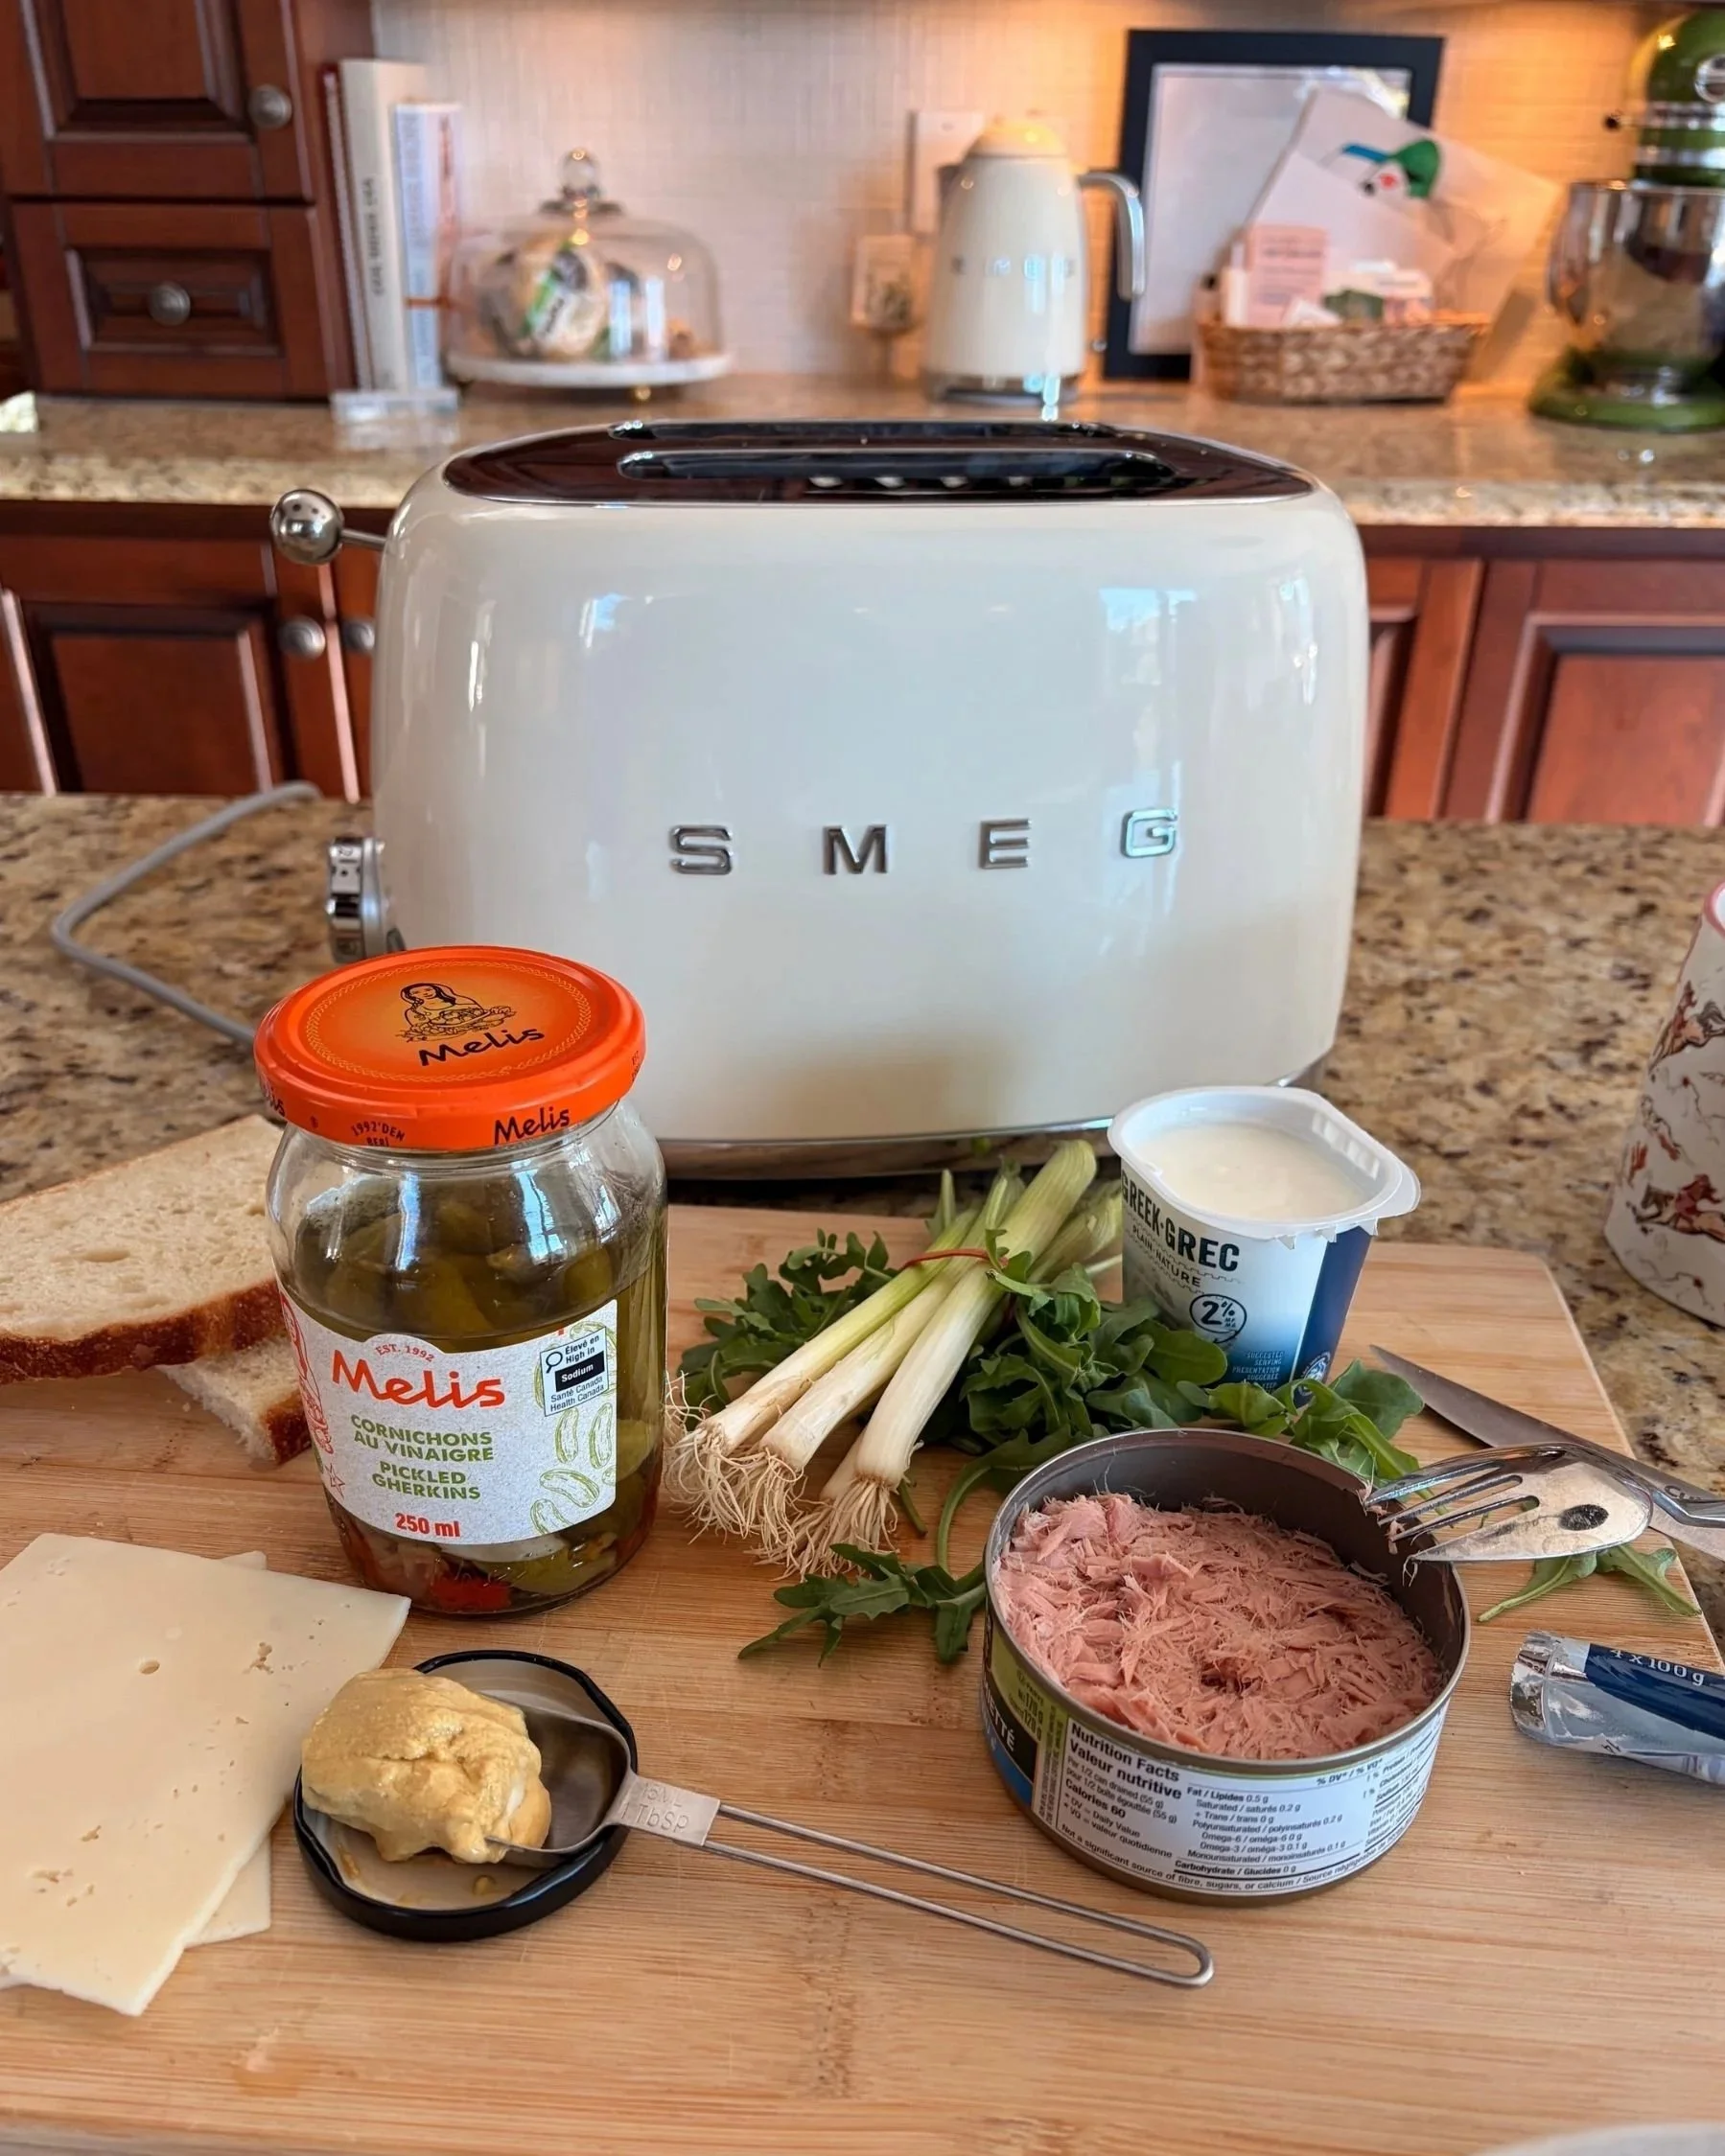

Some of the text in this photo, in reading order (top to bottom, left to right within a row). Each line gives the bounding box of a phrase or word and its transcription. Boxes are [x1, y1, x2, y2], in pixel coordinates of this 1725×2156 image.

[418, 1028, 545, 1067] Melis
[494, 1106, 571, 1146] Melis
[1155, 1251, 1202, 1287] NATURE
[375, 1343, 435, 1363] EST. 1992
[565, 1334, 600, 1355] Élevé en
[566, 1346, 595, 1364] High in
[332, 1349, 506, 1409] Melis
[561, 1363, 594, 1382] Sodium
[549, 1383, 605, 1413] Health Canada
[550, 1375, 603, 1403] Santé Canada
[350, 1413, 494, 1446] CORNICHONS
[353, 1430, 495, 1462] AU VINAIGRE
[371, 1472, 481, 1500] GHERKINS
[379, 1460, 467, 1485] PICKLED
[394, 1512, 461, 1538] 250 ml
[1649, 1658, 1688, 1678] 100
[1691, 1672, 1706, 1687] g
[1071, 1723, 1180, 1782] Nutrition Facts
[1070, 1738, 1182, 1800] Valeur nutritive
[1065, 1778, 1127, 1820] Calories 60
[1186, 1786, 1202, 1797] Fat
[1210, 1791, 1245, 1802] Lipides
[1246, 1794, 1261, 1802] 0.5
[1262, 1796, 1270, 1804] g
[1196, 1799, 1239, 1813] Saturated
[1278, 1803, 1294, 1813] 0.2
[1294, 1803, 1301, 1813] g
[1092, 1810, 1114, 1828] Daily
[1115, 1821, 1141, 1839] Value
[1192, 1820, 1261, 1834] Polyunsaturated
[1203, 1811, 1230, 1821] Trans
[1236, 1815, 1259, 1823] trans
[1268, 1816, 1274, 1824] g
[1091, 1820, 1118, 1839] valeur
[1119, 1834, 1173, 1858] quotidienne
[1200, 1842, 1240, 1854] Omega-3
[1201, 1831, 1242, 1843] Omega-6
[1295, 1833, 1303, 1842] g
[1061, 1823, 1076, 1839] Not
[1084, 1839, 1131, 1866] significant
[1131, 1861, 1164, 1878] source
[1165, 1872, 1176, 1881] of
[1244, 1882, 1256, 1890] or
[1257, 1878, 1294, 1890] calcium
[1302, 1868, 1333, 1884] Source
[1175, 1860, 1236, 1876] Carbohydrate
[1244, 1866, 1282, 1876] Glucides
[1187, 1849, 1261, 1864] Monounsaturated
